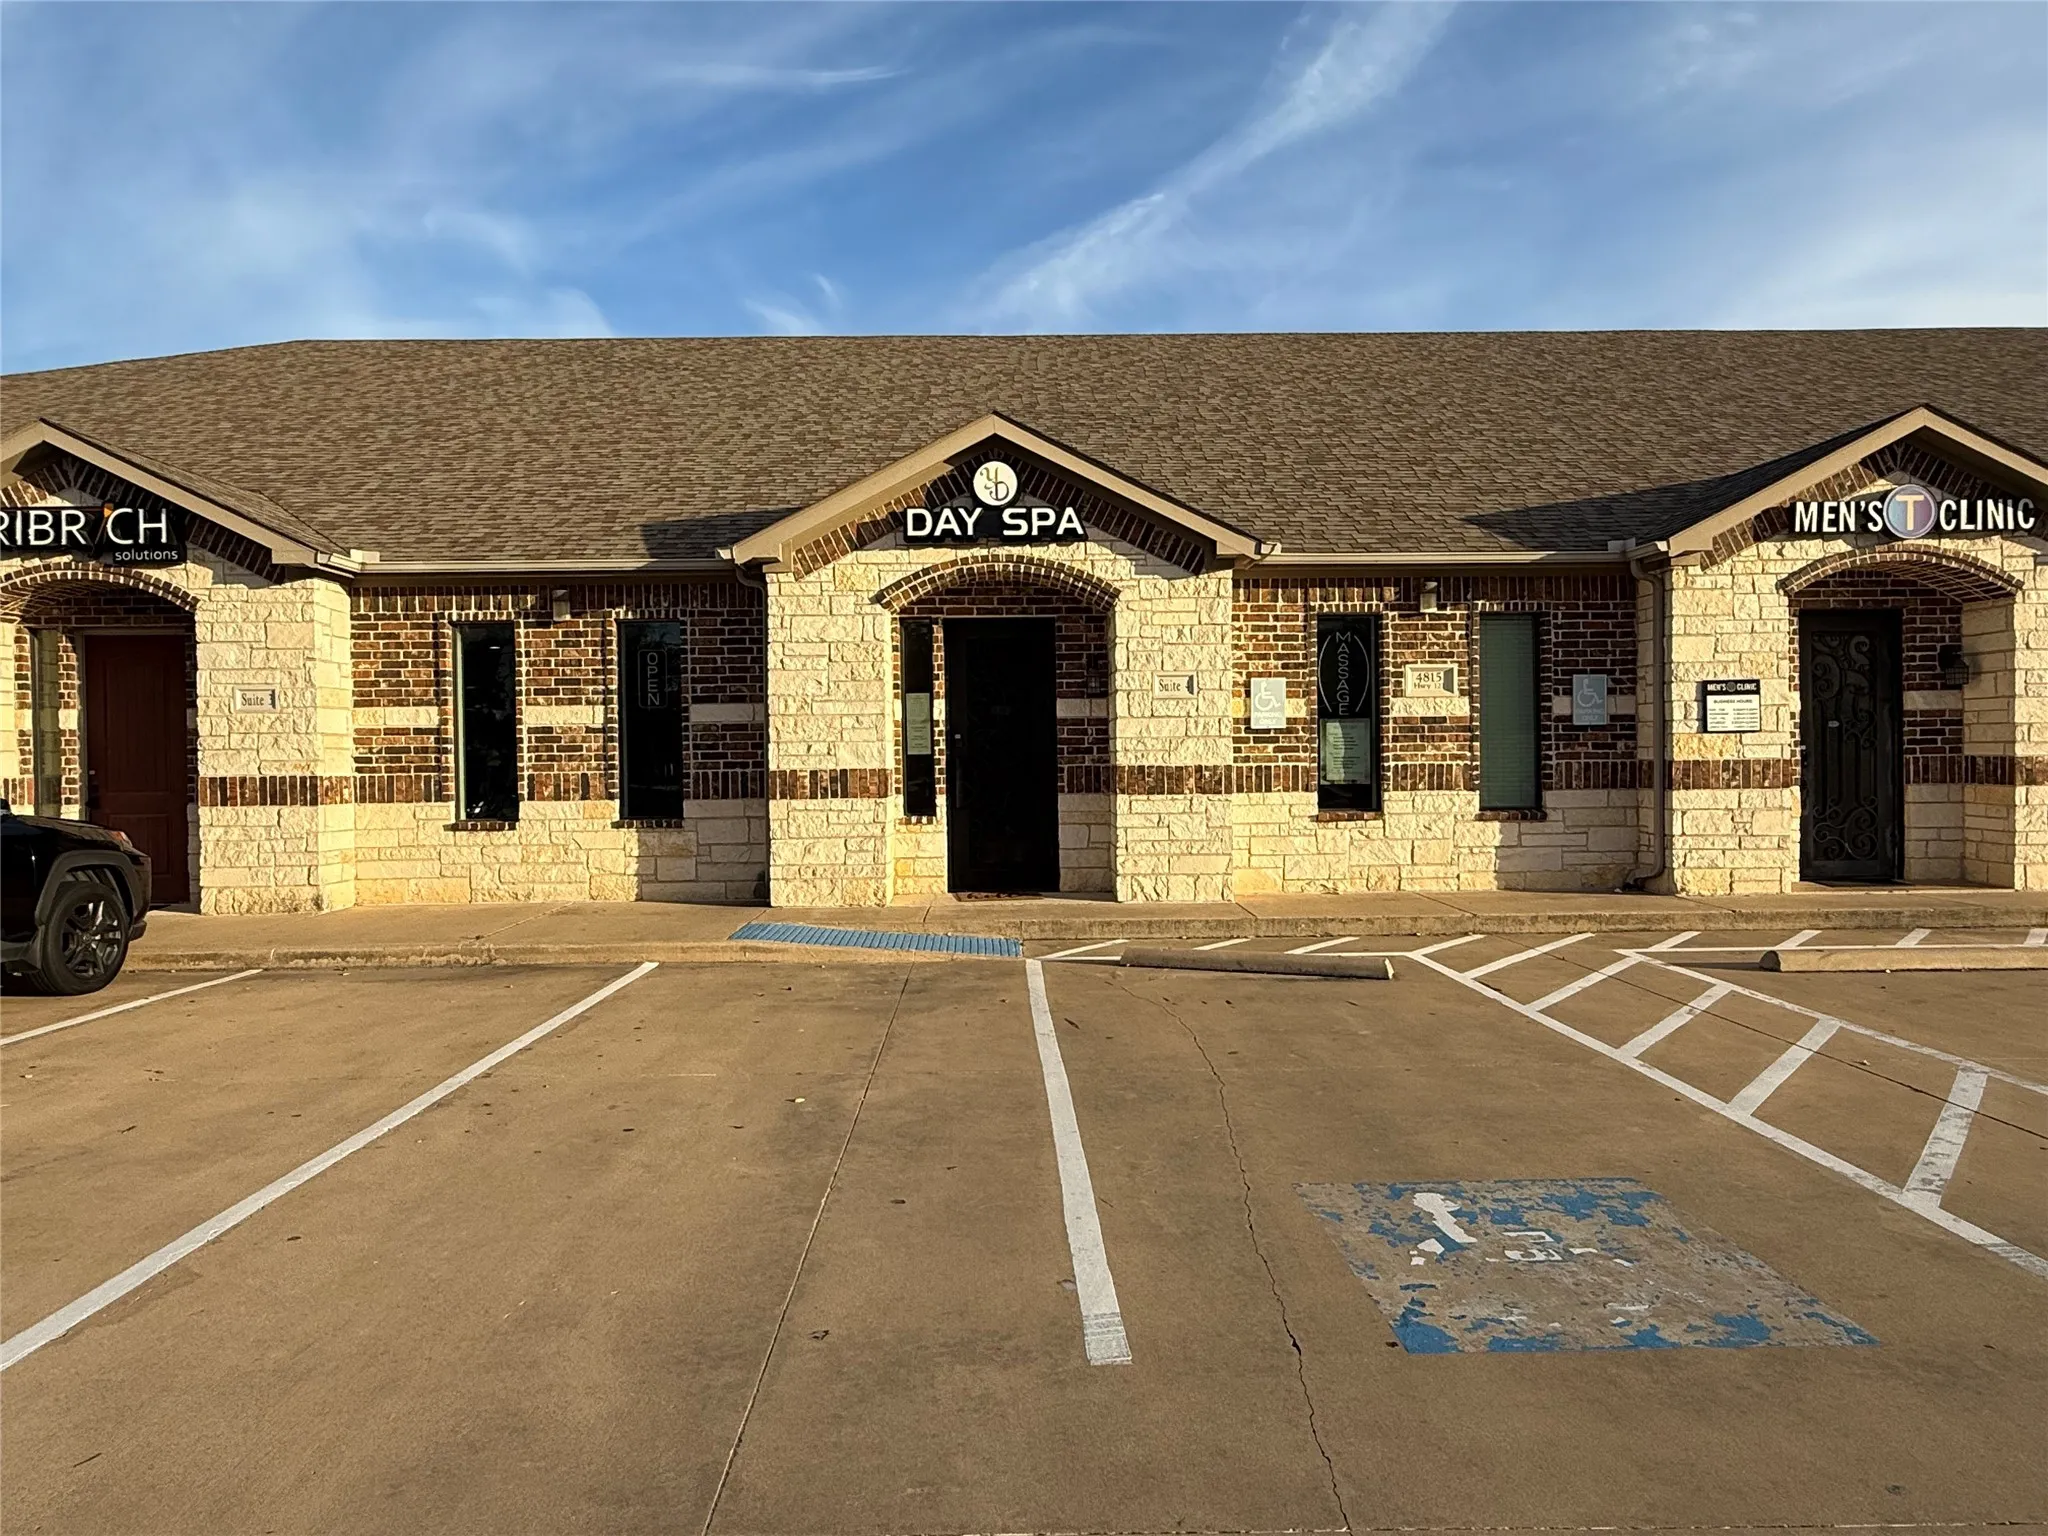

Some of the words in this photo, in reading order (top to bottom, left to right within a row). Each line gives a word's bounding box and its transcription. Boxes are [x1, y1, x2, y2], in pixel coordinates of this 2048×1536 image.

[1795, 501, 1883, 532] MEN'S
[1895, 494, 1925, 531] T
[1940, 498, 2035, 531] CLINIC
[906, 507, 984, 536] DAY
[1002, 507, 1084, 536] SPA
[115, 549, 179, 561] solutions
[647, 652, 660, 705] OPEN
[1336, 631, 1351, 715] MASSAGE
[1415, 671, 1442, 683] 4815
[1159, 678, 1181, 692] Suite
[1413, 682, 1431, 690] Hwy
[1736, 682, 1757, 690] CLINIC
[241, 692, 264, 706] Suite
